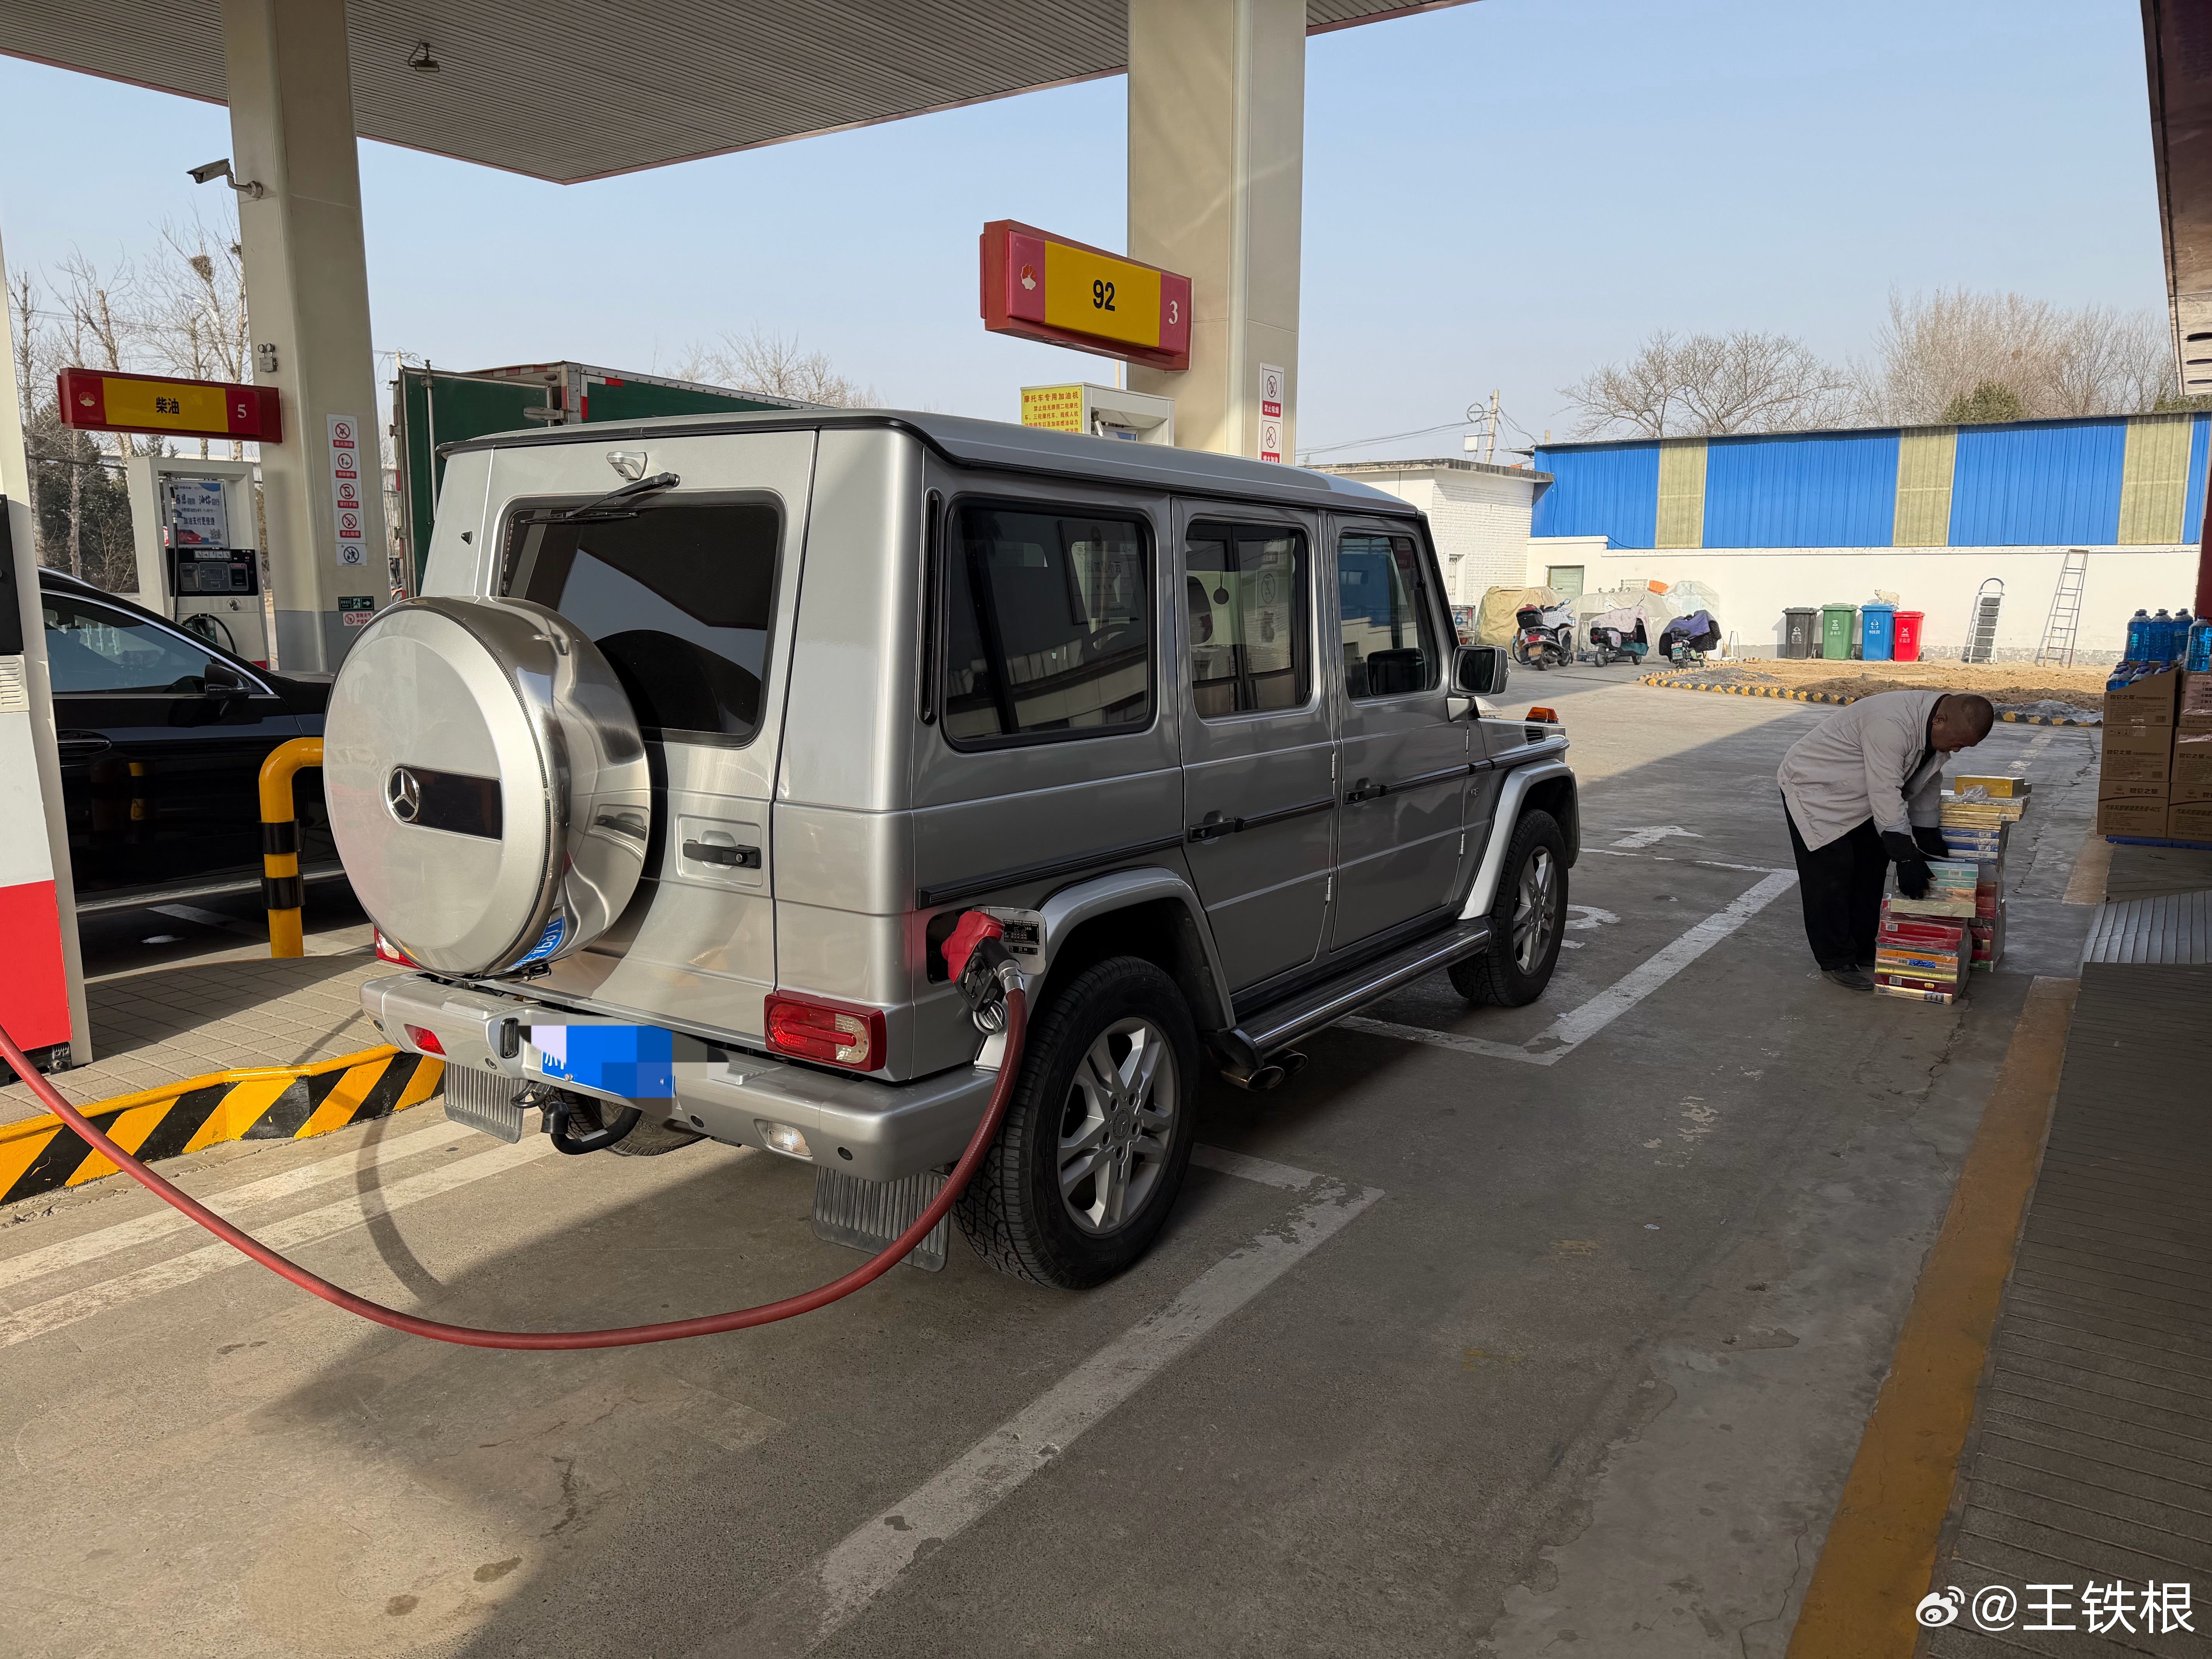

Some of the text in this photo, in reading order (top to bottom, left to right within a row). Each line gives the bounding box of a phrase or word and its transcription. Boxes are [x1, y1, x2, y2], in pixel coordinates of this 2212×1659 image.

[1093, 279, 1115, 312] 92
[1168, 300, 1178, 325] 3
[1024, 392, 1079, 403] 摩托车专用加油机
[156, 397, 180, 414] 柴油
[237, 404, 247, 418] 5
[1034, 403, 1079, 411] 禁止给无牌照二轮摩托
[184, 517, 215, 526] 加油支付更便捷
